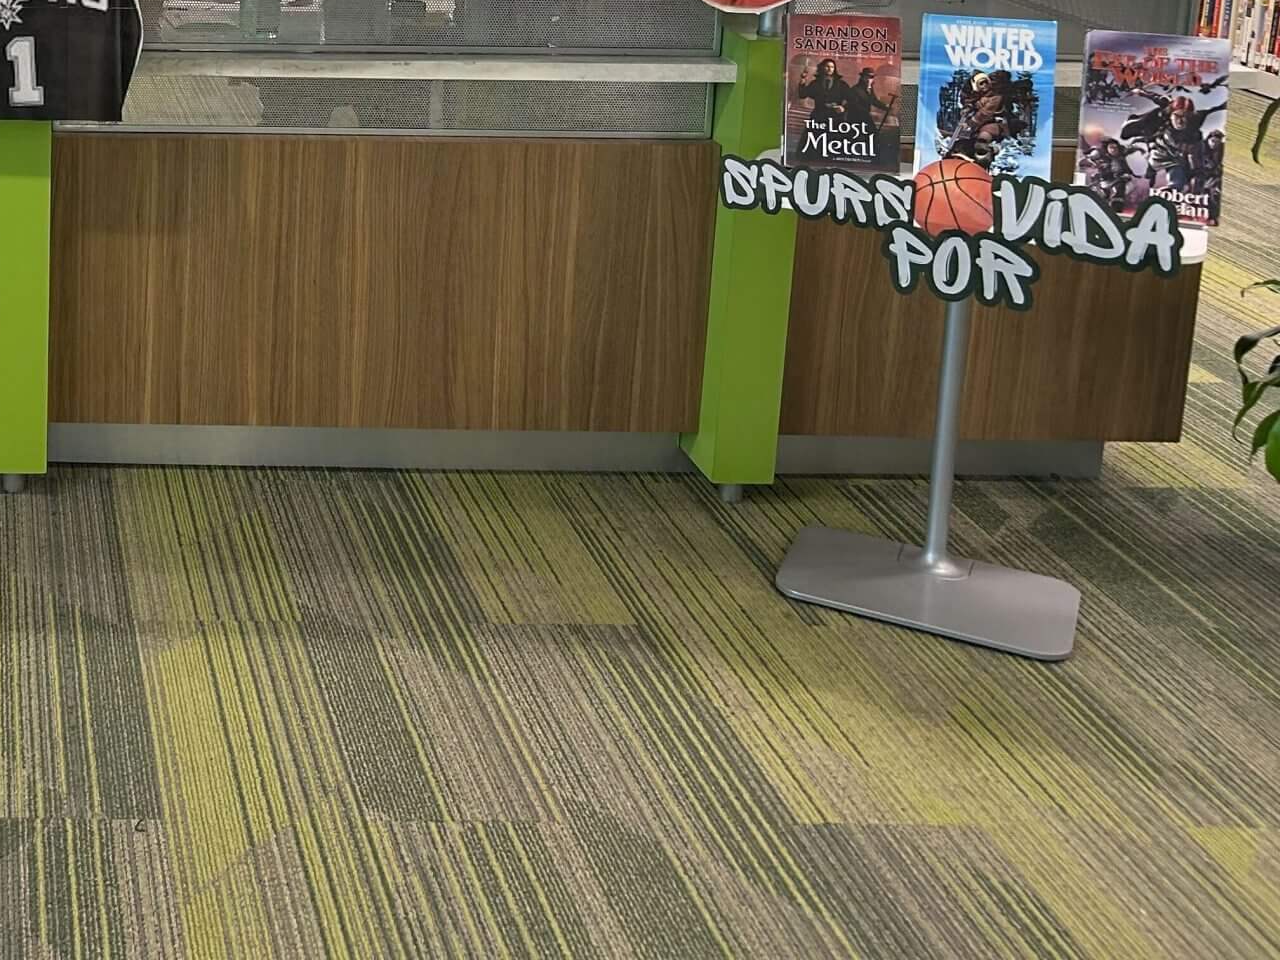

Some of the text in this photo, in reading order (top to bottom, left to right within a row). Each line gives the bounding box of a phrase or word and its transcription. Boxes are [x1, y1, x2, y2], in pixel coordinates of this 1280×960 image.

[804, 24, 888, 40] BRANDON
[940, 23, 1036, 51] WINTER
[794, 38, 897, 54] SANDERSON
[943, 44, 1043, 73] WORLD
[5, 36, 45, 107] 1
[803, 118, 869, 139] The Lost
[801, 132, 877, 158] Metal
[722, 157, 914, 227] SPURS
[1148, 186, 1210, 206] Robert
[889, 227, 1033, 304] POR
